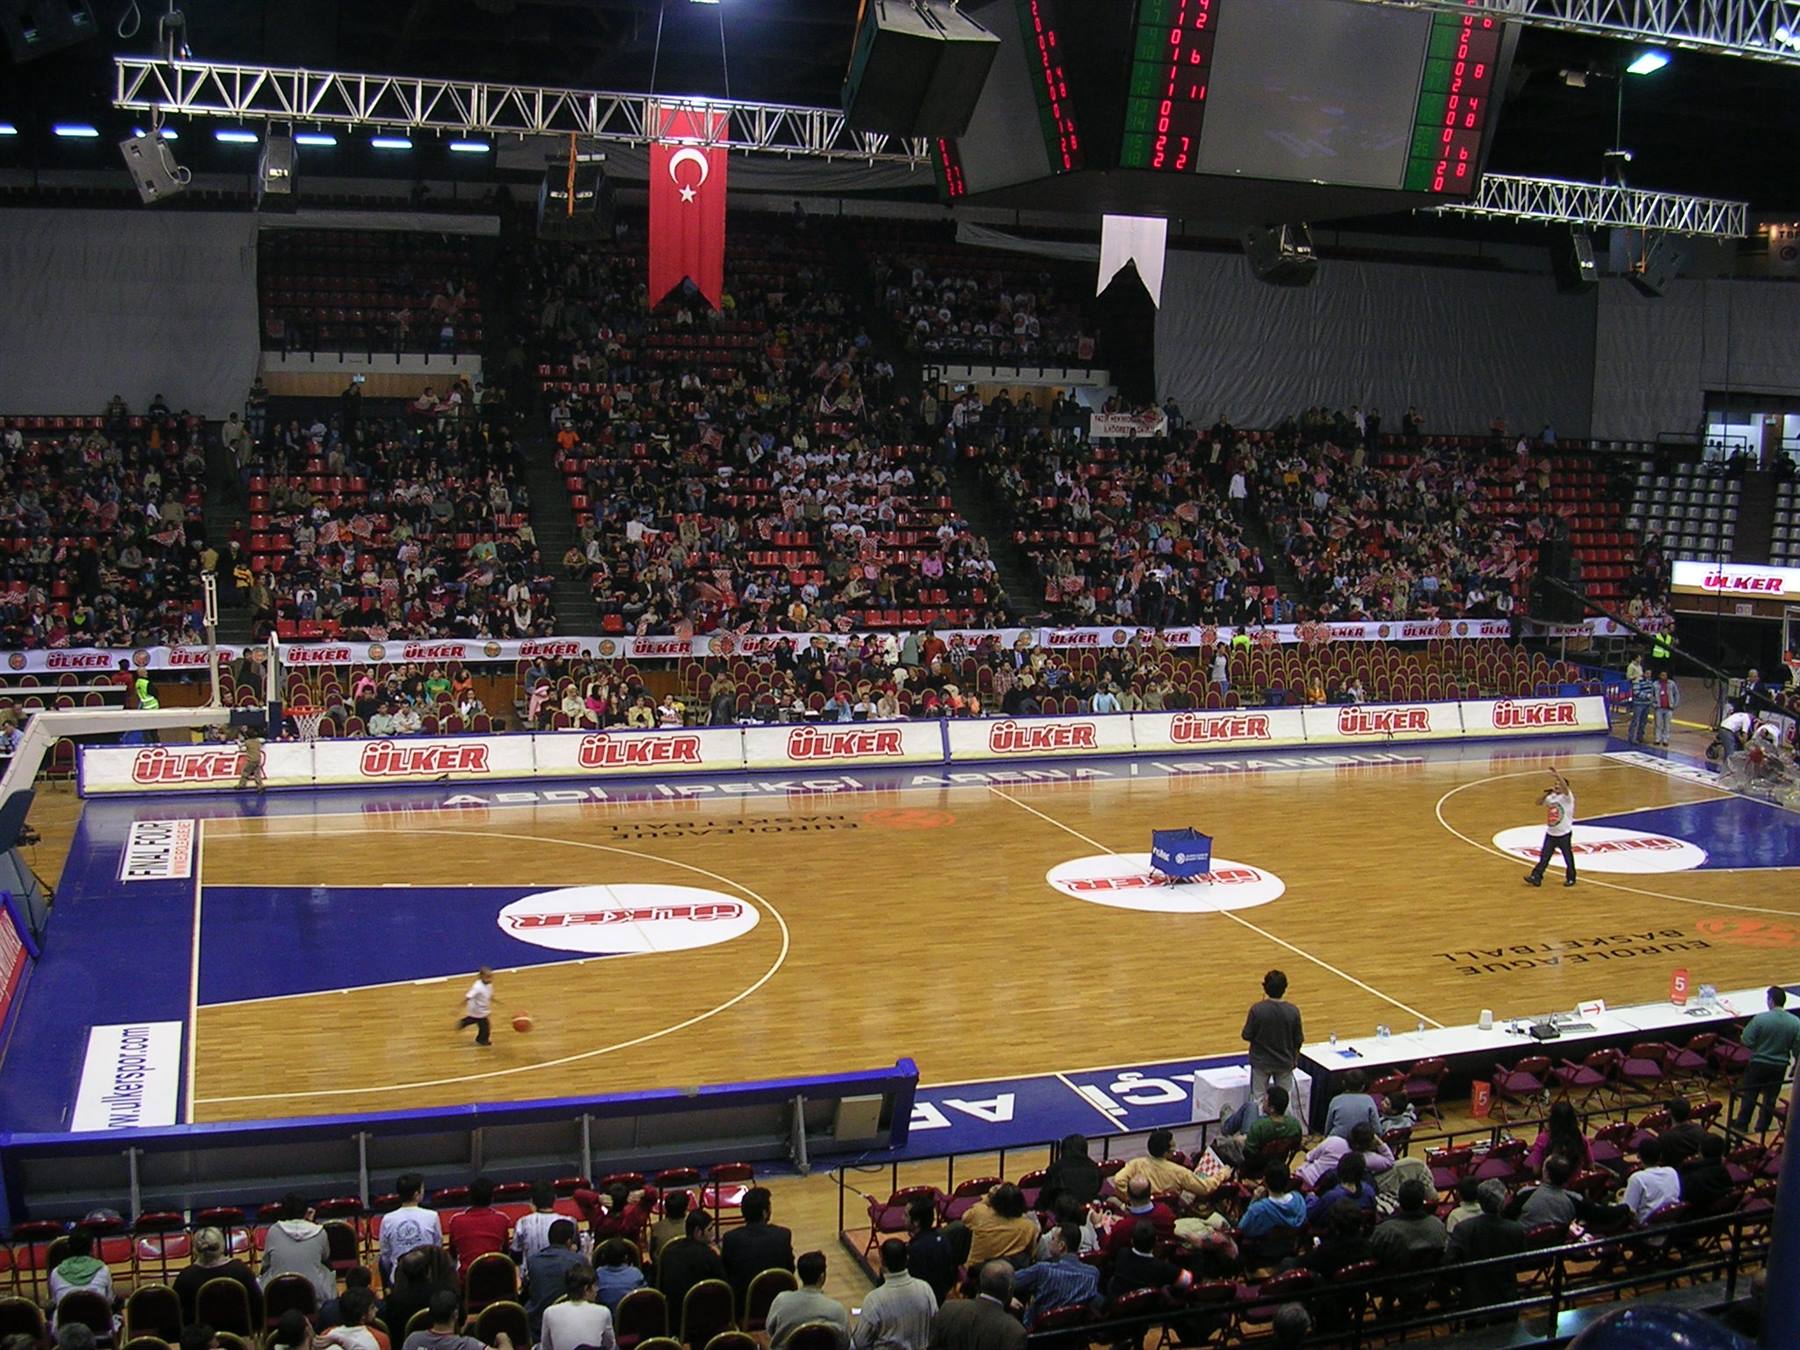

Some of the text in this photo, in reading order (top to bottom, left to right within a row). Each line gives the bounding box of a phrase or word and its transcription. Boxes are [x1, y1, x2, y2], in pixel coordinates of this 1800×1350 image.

[1195, 12, 1208, 29] 2
[1461, 28, 1472, 43] 2
[1451, 78, 1462, 93] 2
[1156, 135, 1167, 151] 2
[1181, 136, 1190, 152] 7
[1153, 153, 1165, 168] 2
[1175, 153, 1187, 170] 2
[1436, 160, 1447, 176] 2
[1703, 570, 1784, 592] ÜLKER
[634, 638, 692, 656] ÜLKER
[1048, 631, 1098, 646] ÜLKER
[288, 645, 350, 663] ÜLKER
[404, 643, 465, 661] ÜLKER
[519, 639, 580, 657] ÜLKER
[48, 651, 112, 669] ÜLKER
[1338, 705, 1431, 736] ÜLKER
[1494, 701, 1577, 729] ÜLKER
[990, 720, 1097, 752] ÜLKER
[1171, 713, 1271, 744] ÜLKER
[579, 733, 701, 768] ÜLKER
[788, 726, 903, 760] ÜLKER
[362, 740, 489, 777] ÜLKER
[911, 767, 1114, 785] ARENA
[505, 902, 743, 931] ÜLKER
[1432, 929, 1686, 963] BASKETBALL
[1455, 939, 1712, 976] EUROLEAGUE
[1674, 975, 1686, 992] 5
